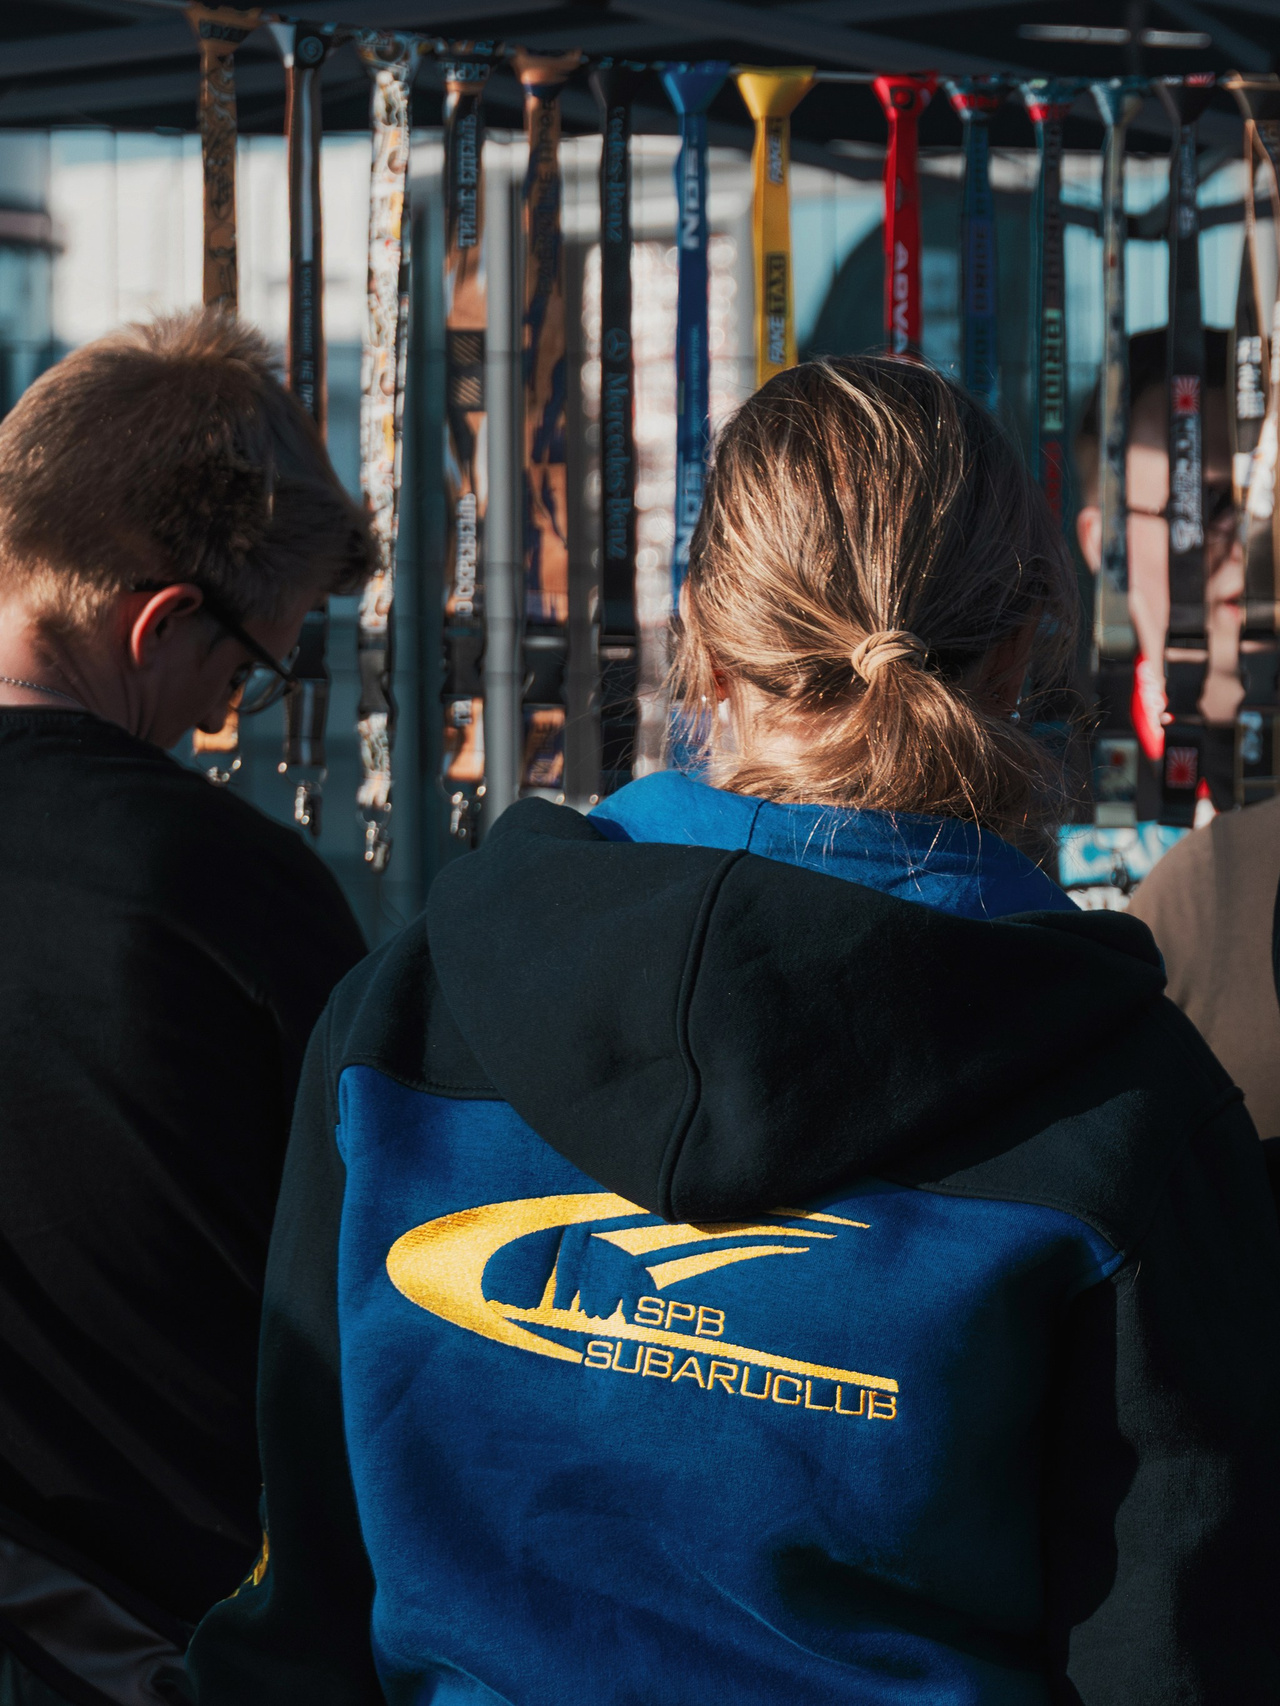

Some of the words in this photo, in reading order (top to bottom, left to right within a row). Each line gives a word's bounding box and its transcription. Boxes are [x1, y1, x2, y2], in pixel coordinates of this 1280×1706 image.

[457, 188, 477, 248] ТИШЕ
[682, 146, 700, 250] NOS
[1043, 314, 1063, 425] BRIDE
[604, 372, 631, 561] Mercedes-Benz
[633, 1295, 726, 1337] SPB
[583, 1340, 898, 1421] SUBARUCLUB
